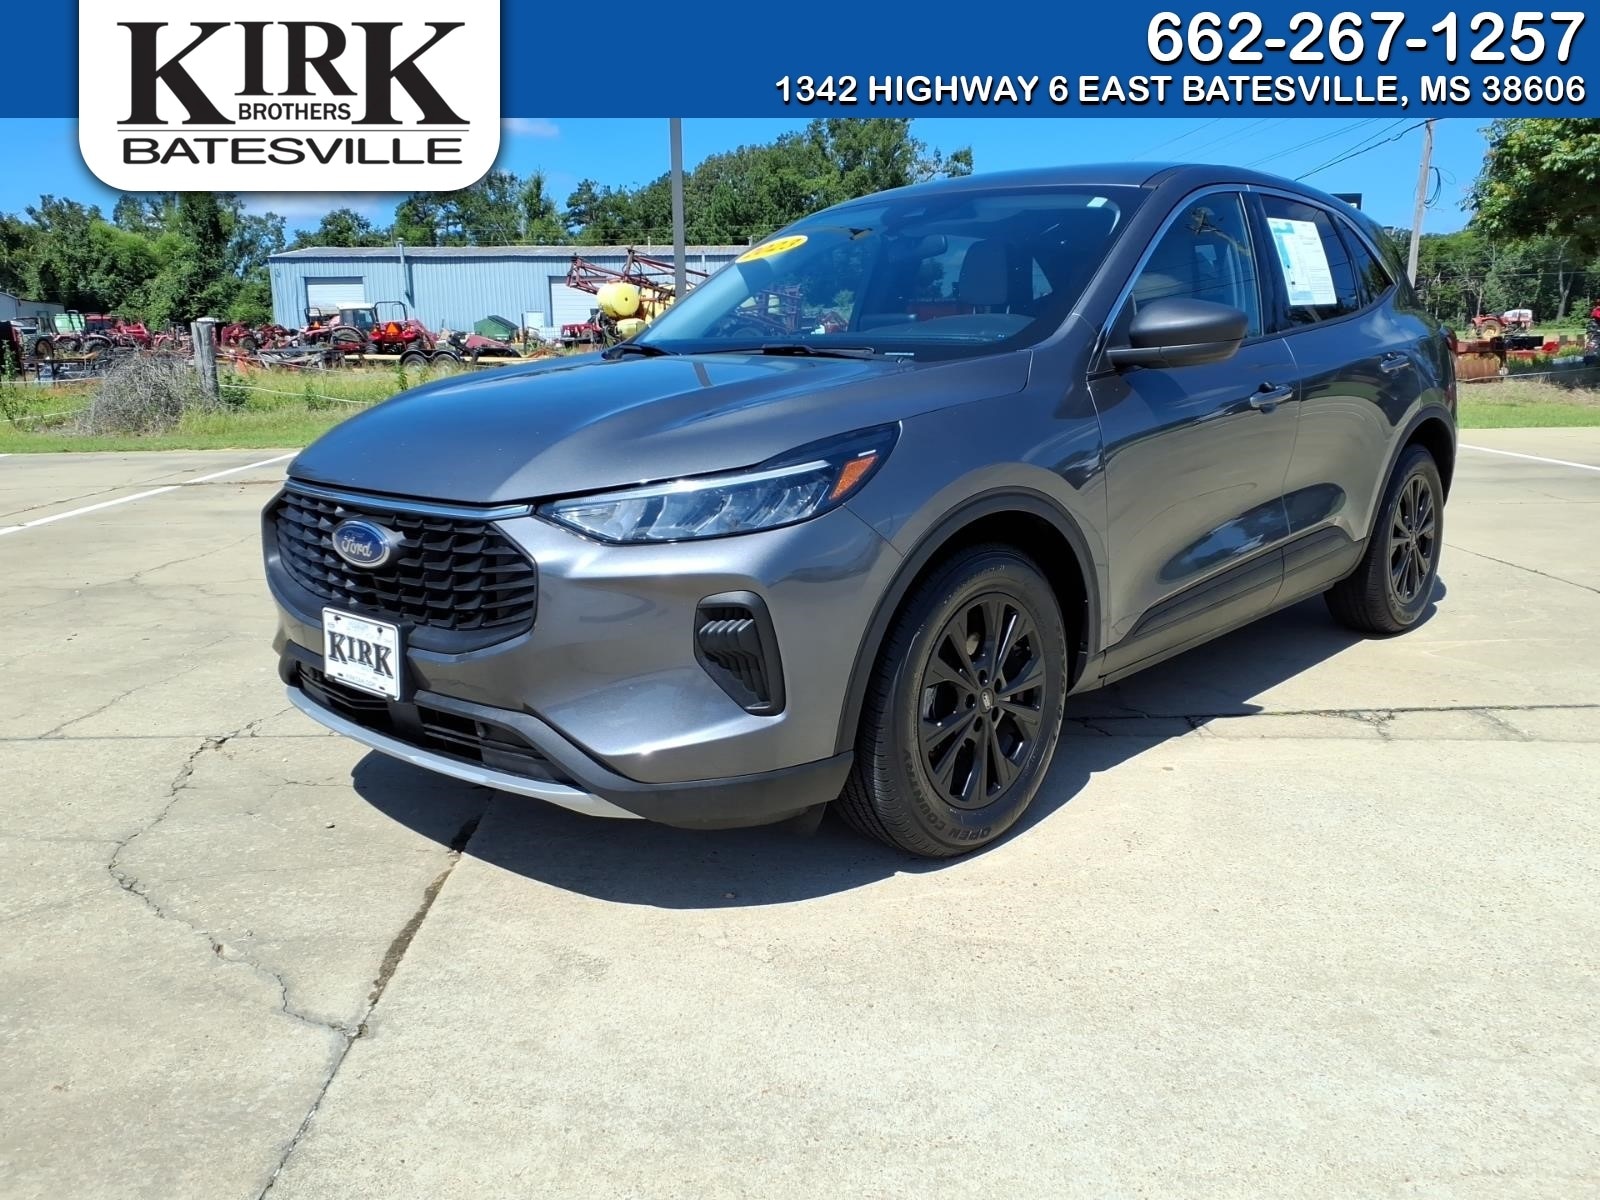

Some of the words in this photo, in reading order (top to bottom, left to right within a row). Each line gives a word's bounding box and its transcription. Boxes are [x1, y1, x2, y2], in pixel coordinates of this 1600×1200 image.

[341, 534, 373, 557] Ford
[327, 630, 395, 680] KIRK
[948, 826, 992, 841] OPEN
